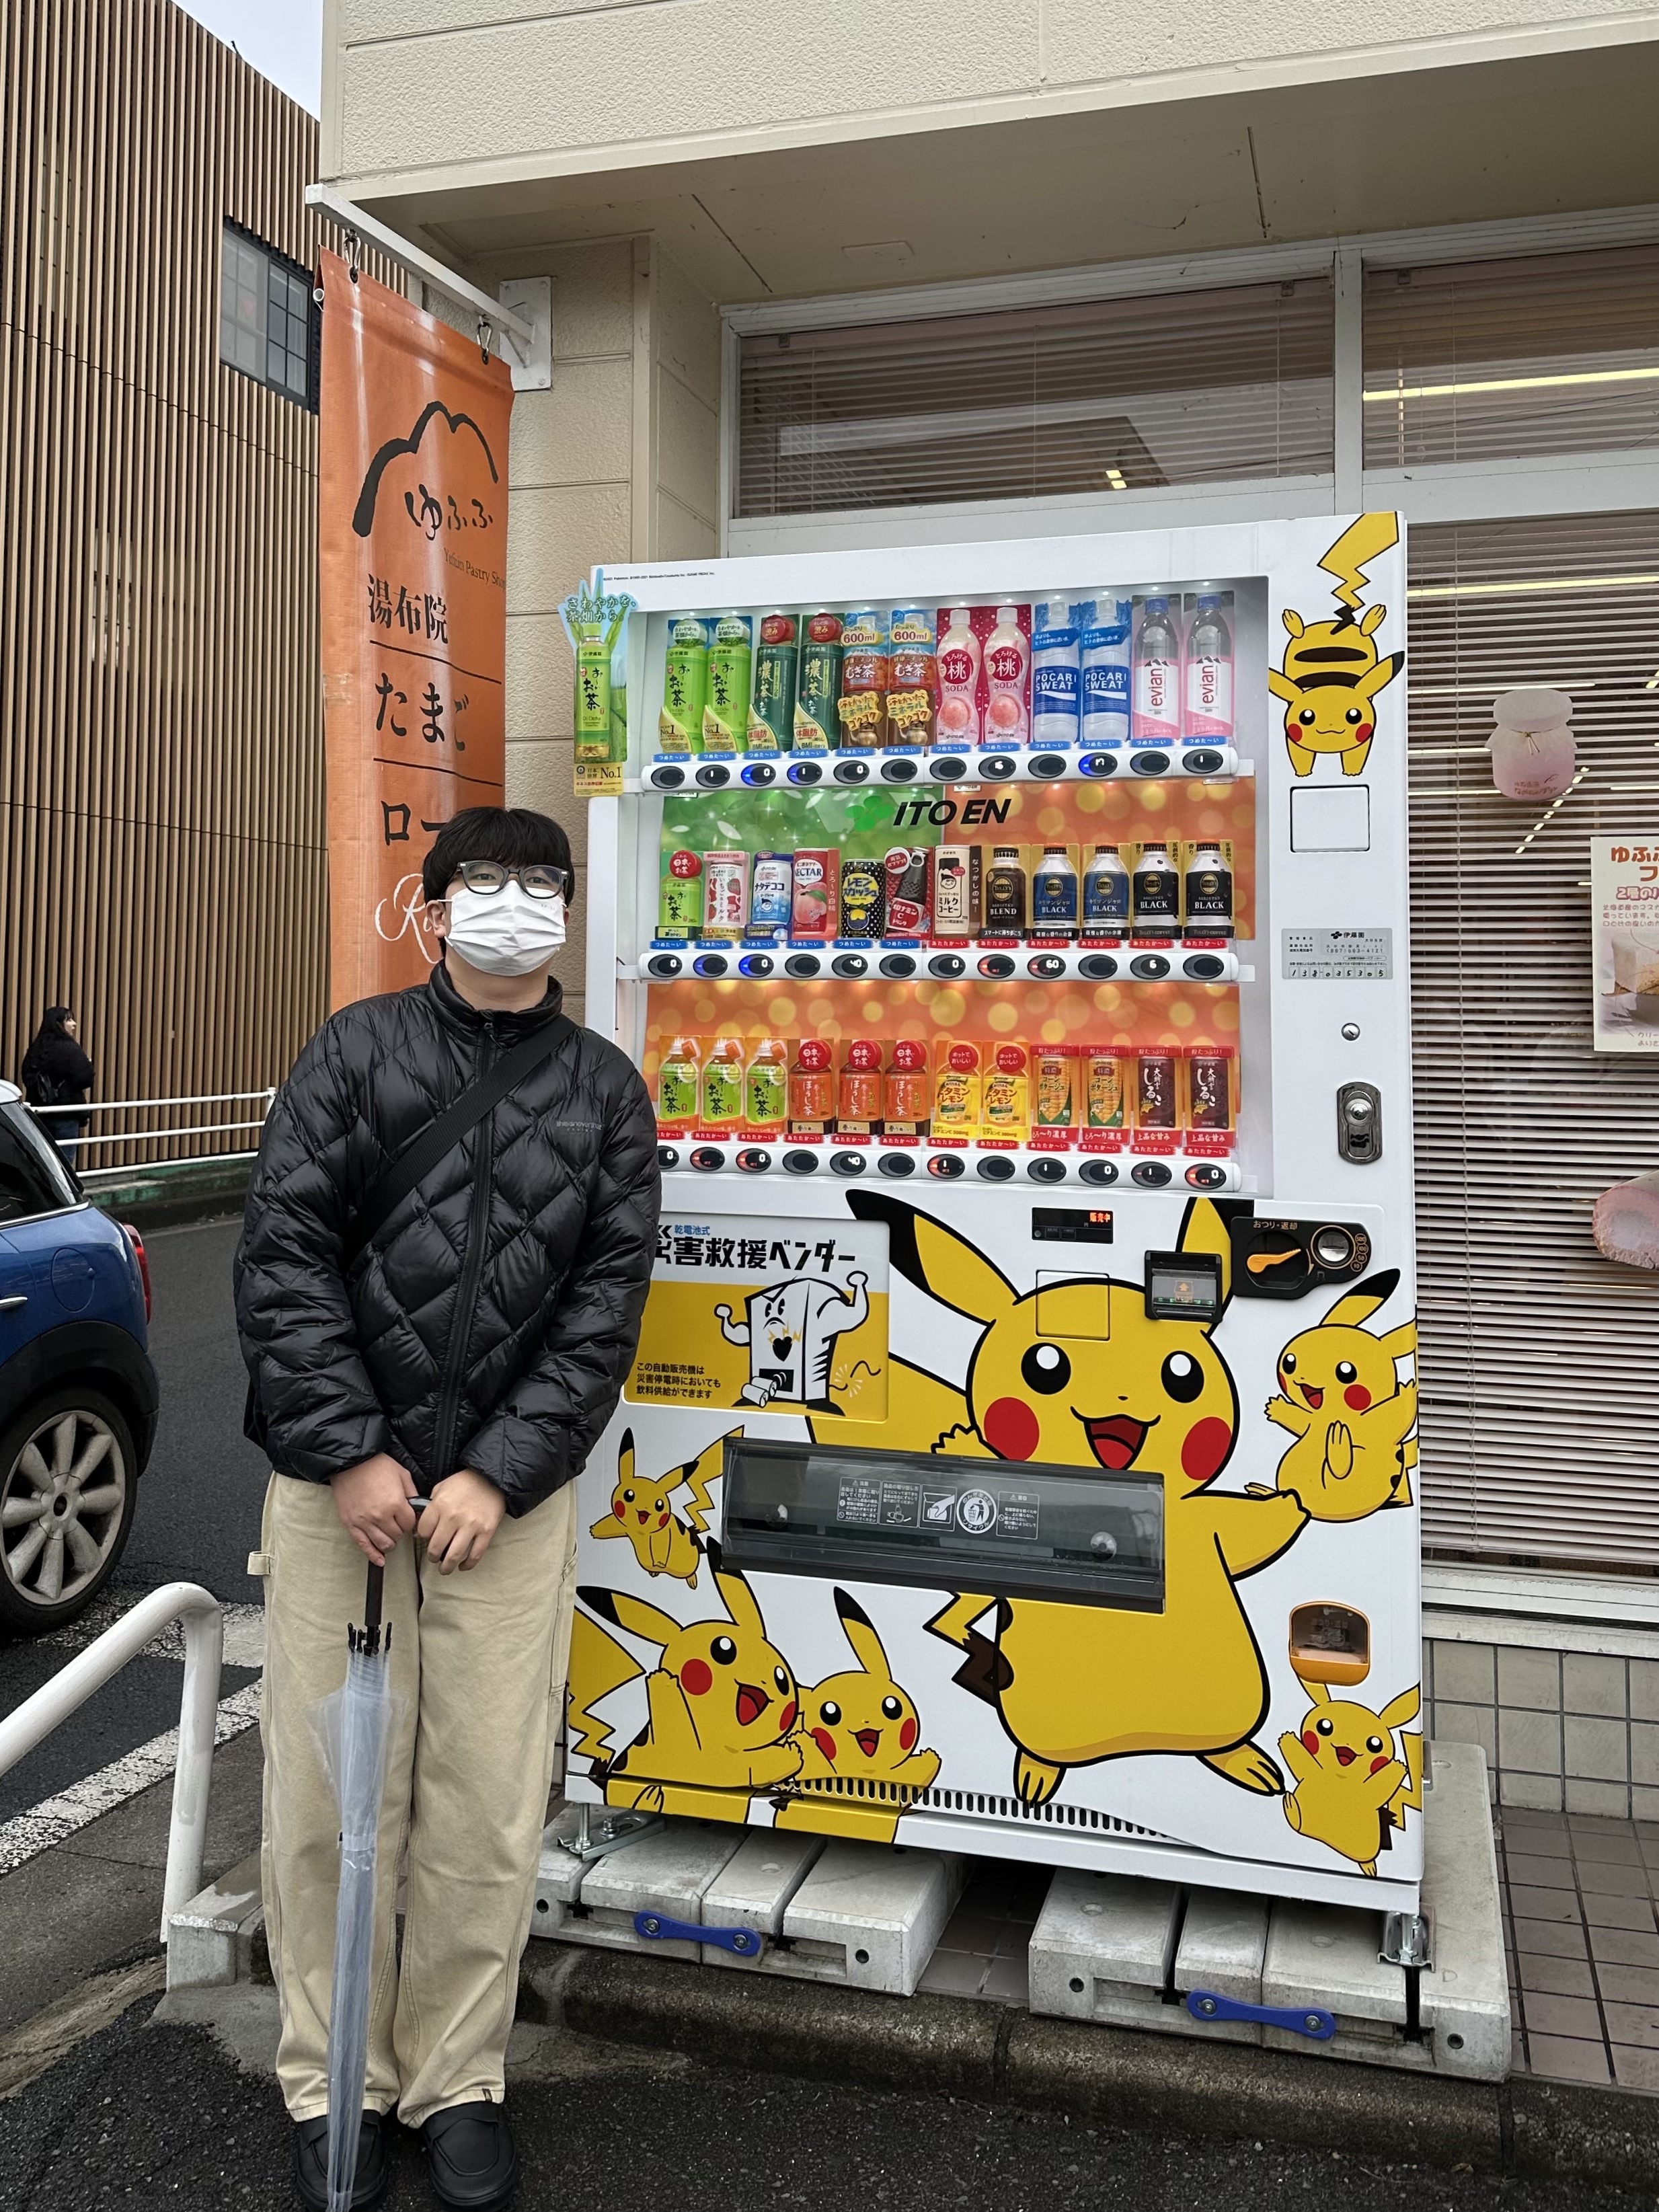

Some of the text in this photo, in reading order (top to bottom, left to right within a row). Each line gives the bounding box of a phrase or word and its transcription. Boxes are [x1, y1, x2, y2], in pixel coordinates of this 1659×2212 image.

[404, 484, 494, 541] ゆふふ
[466, 560, 490, 585] Pastry
[367, 574, 449, 644] 湯布院
[568, 595, 636, 609] さわやかを、
[568, 610, 624, 623] 茶畑から。
[843, 632, 876, 644] 600ml
[894, 631, 927, 642] 600ml
[946, 652, 968, 662] とろける
[995, 650, 1017, 659] とろける
[845, 664, 877, 679] むぎ茶
[894, 662, 927, 678] むぎ茶
[947, 660, 966, 681] 桃
[996, 658, 1016, 677] 桃
[758, 660, 774, 698] 濃い茶
[804, 658, 823, 697] 濃い茶
[1036, 673, 1077, 682] POCARI
[1085, 673, 1127, 682] POCARI
[1200, 665, 1214, 704] evian
[669, 675, 687, 707] お茶
[713, 673, 730, 705] お茶
[945, 685, 969, 693] SODA
[994, 681, 1018, 689] SODA
[1036, 681, 1074, 691] SWEAT
[1085, 681, 1124, 691] SWEAT
[1149, 668, 1163, 707] evian
[583, 678, 601, 711] お茶
[375, 673, 469, 753] たまご
[848, 711, 878, 729] ゴクゴク
[897, 711, 928, 727] ゴクゴク
[601, 767, 622, 779] No.1
[893, 798, 1012, 826] ITO EN
[381, 800, 445, 846] ロー
[795, 868, 822, 877] NECTAR
[755, 882, 785, 892] ナタデココ
[847, 877, 872, 887] レモン
[843, 888, 878, 897] スカッシュ
[668, 894, 682, 921] お茶
[939, 897, 959, 905] ミルク
[1140, 901, 1169, 909] BLACK
[1194, 901, 1225, 909] BLACK
[1144, 1068, 1162, 1106] しるこ
[1197, 1068, 1216, 1106] しるこ
[664, 1082, 681, 1114] お茶
[708, 1083, 726, 1115] お茶
[754, 1085, 772, 1116] お茶
[802, 1080, 816, 1116] ほうじ茶
[850, 1079, 862, 1116] ほうじ茶
[895, 1080, 908, 1116] ほうじ茶
[1032, 1130, 1067, 1139] とろ〜り濃厚
[1085, 1132, 1122, 1141] とろ〜り濃厚
[1137, 1132, 1171, 1141] 上品な甘み
[1191, 1133, 1226, 1142] 上品な甘み
[1089, 1212, 1111, 1223] 販売中
[674, 1225, 711, 1235] 乾電池式
[1253, 1220, 1298, 1230] おつり・返却
[637, 1363, 705, 1375] この自動販売機は
[636, 1373, 722, 1388] 災害停電時においても
[636, 1385, 712, 1399] 飲料供給ができます
